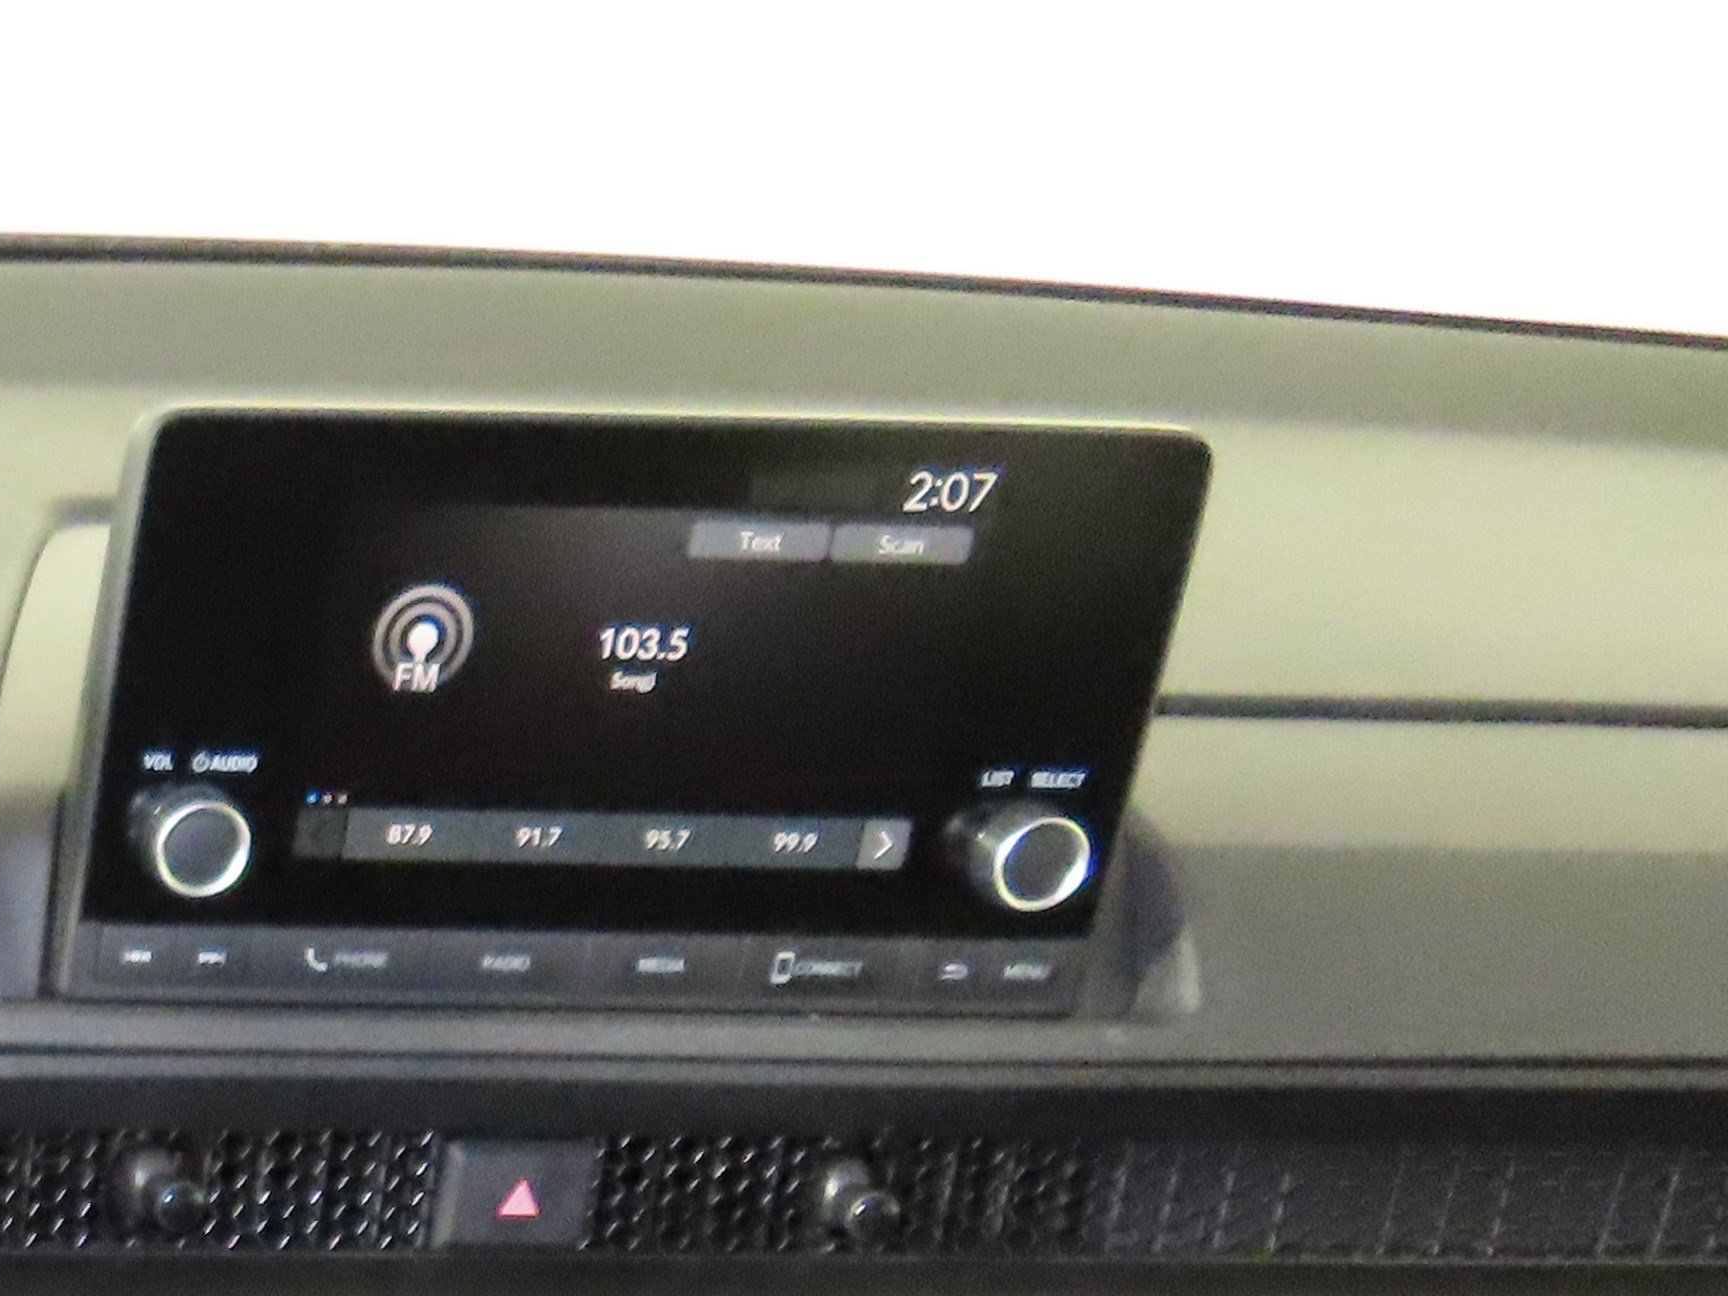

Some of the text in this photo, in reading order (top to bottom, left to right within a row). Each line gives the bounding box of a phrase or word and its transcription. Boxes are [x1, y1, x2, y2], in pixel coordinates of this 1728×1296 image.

[902, 471, 997, 512] 2:07
[740, 531, 782, 551] Text
[878, 534, 924, 556] Scan
[600, 627, 689, 660] 103.5
[394, 662, 441, 691] FM
[386, 824, 433, 846] 87.9
[515, 828, 563, 848] 91.7
[645, 828, 691, 851] 95.7
[772, 832, 818, 854] 99.9
